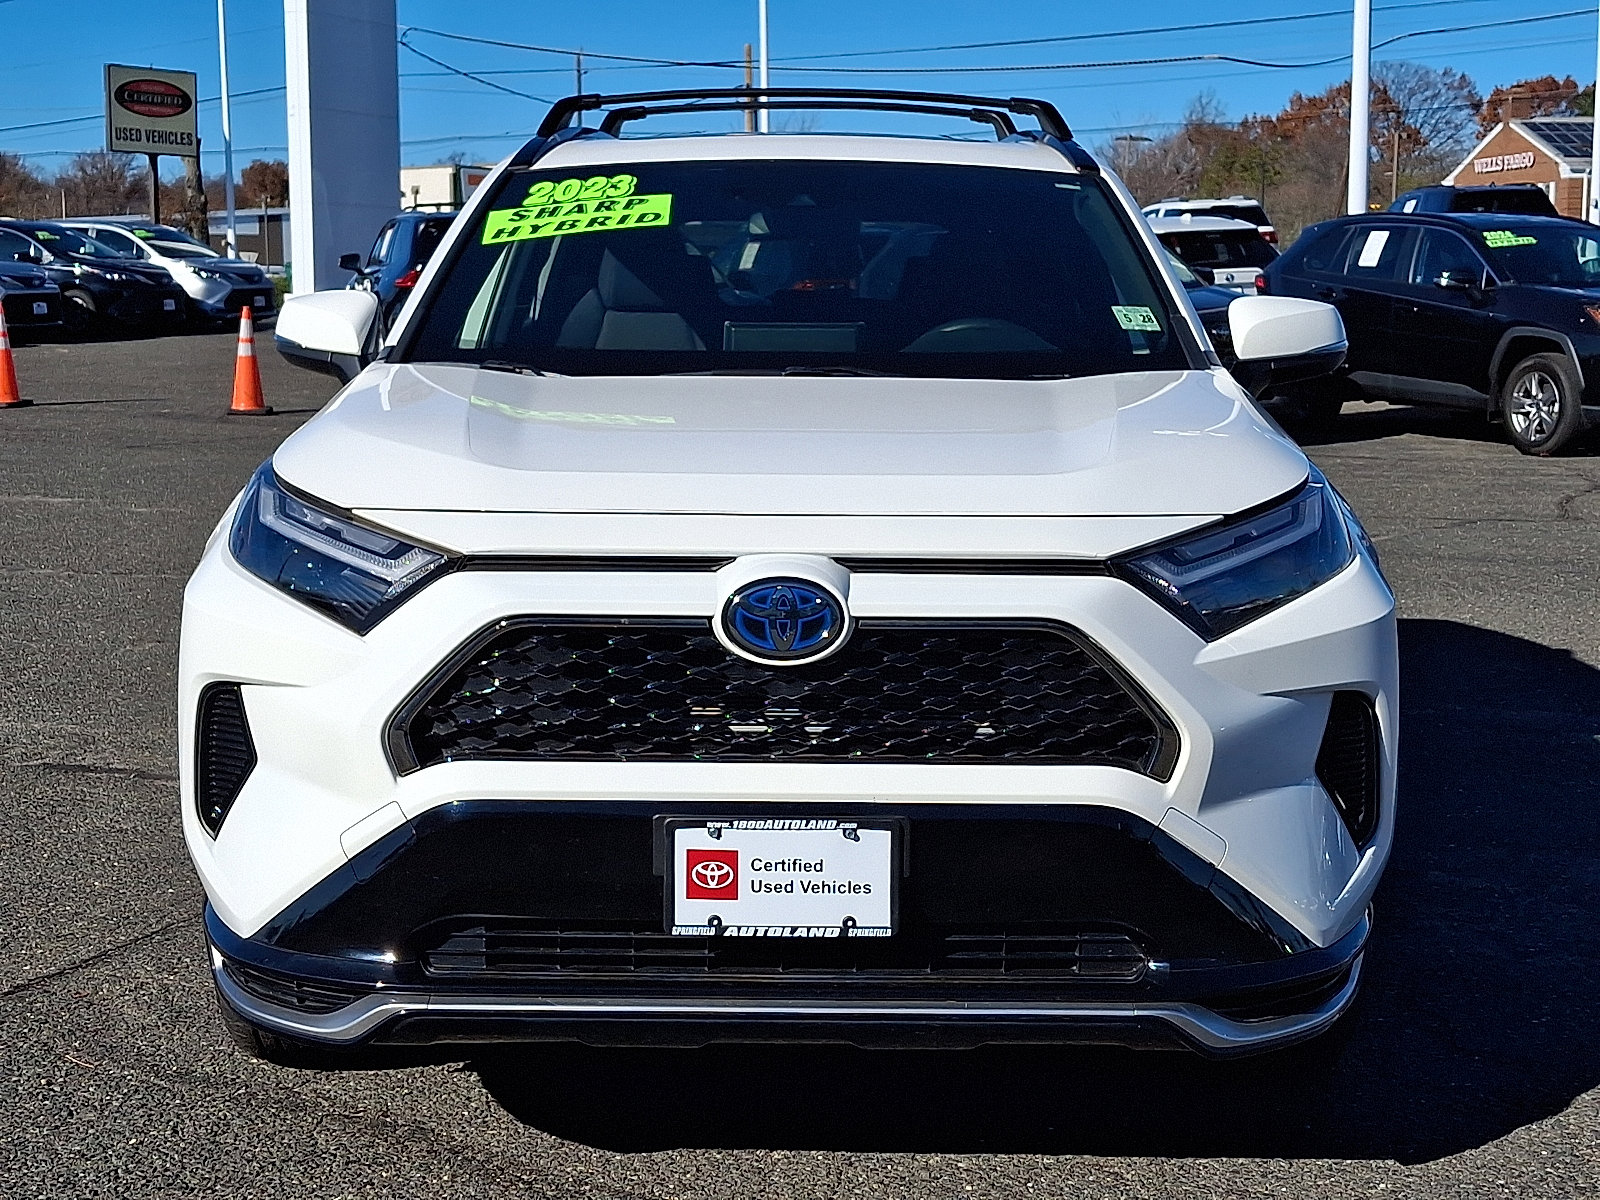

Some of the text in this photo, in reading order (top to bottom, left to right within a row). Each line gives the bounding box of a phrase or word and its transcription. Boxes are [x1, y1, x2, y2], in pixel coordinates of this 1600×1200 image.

[115, 127, 193, 146] USED VEHICLES
[1474, 152, 1534, 173] WELLS FARGO
[522, 174, 637, 206] 2023
[508, 198, 649, 222] SHARP
[491, 212, 662, 240] HYBRID
[1123, 313, 1155, 323] 5 28
[750, 858, 824, 873] Certified
[750, 879, 872, 895] Used Vehicles
[671, 926, 892, 938] SPRINGFIELD AUTOLAND SPRINGFIELD
